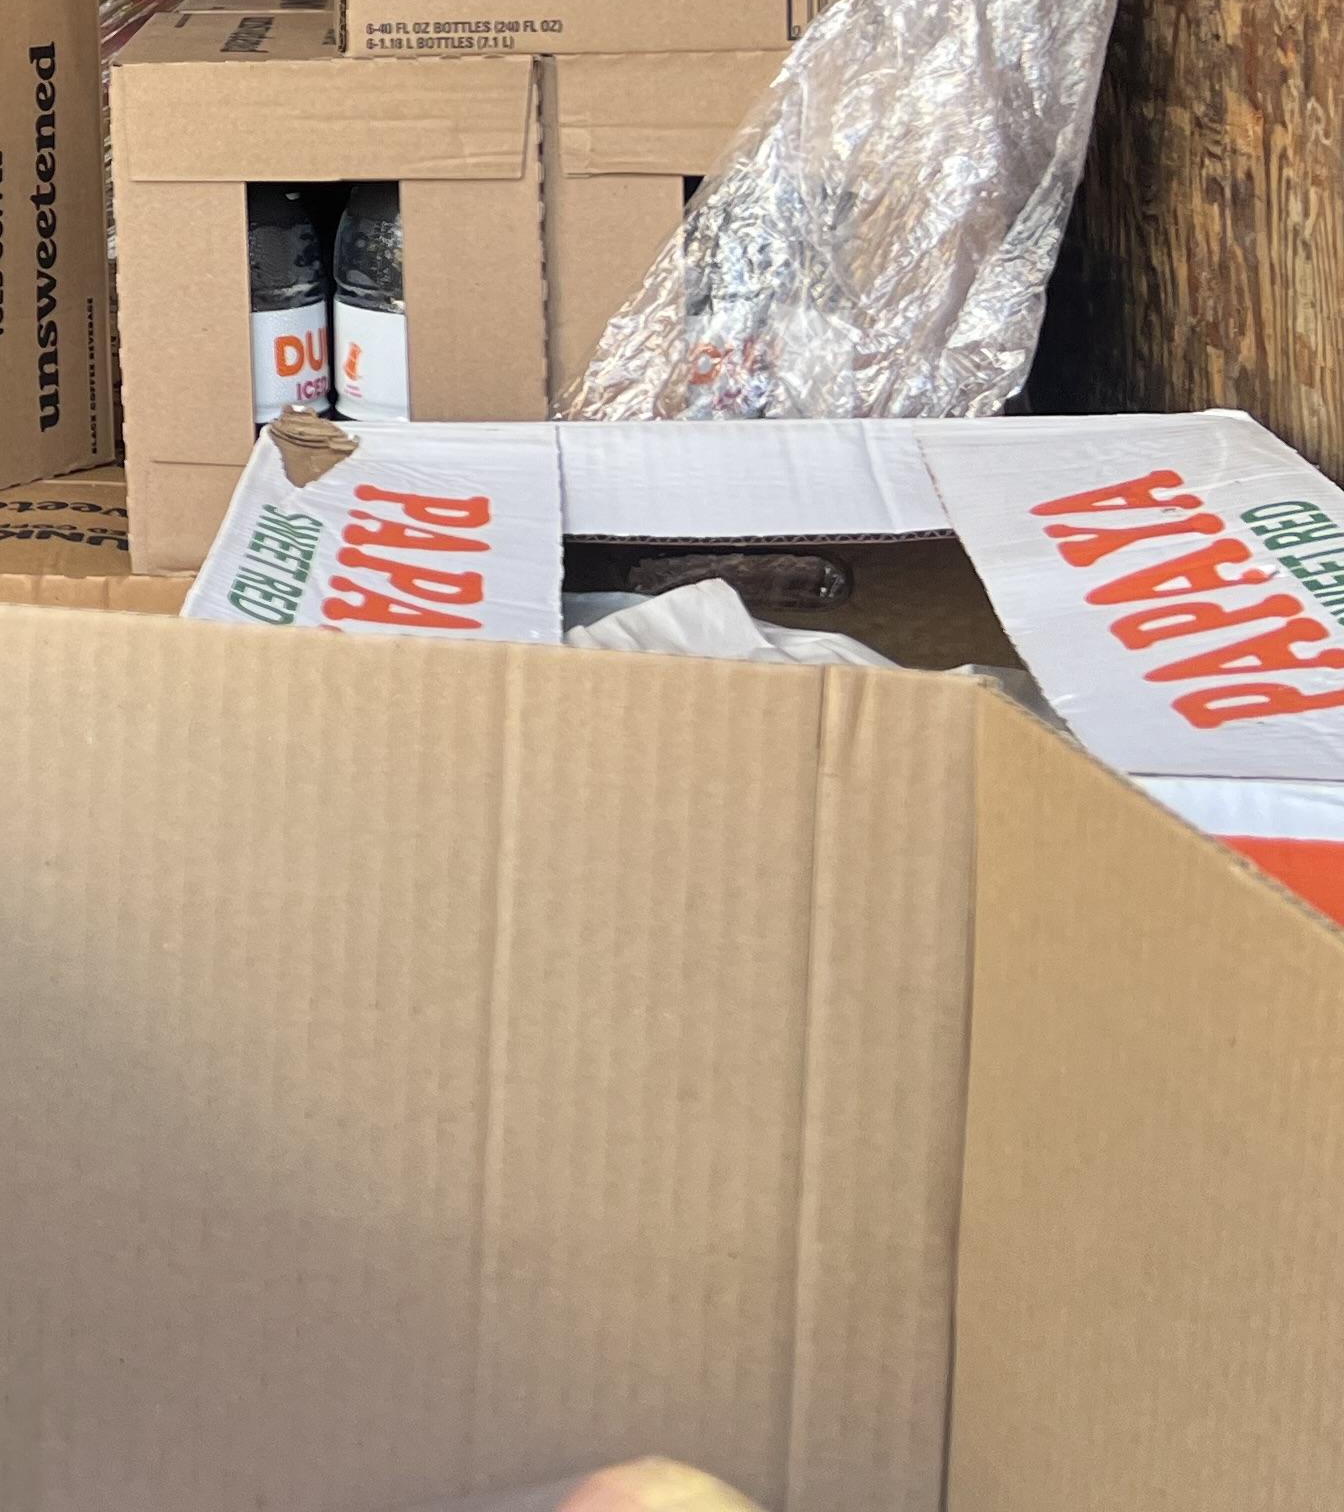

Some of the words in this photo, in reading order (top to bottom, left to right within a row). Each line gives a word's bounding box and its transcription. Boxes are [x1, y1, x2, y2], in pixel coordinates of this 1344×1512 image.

[396, 23, 410, 34] FL
[413, 22, 429, 34] OZ
[433, 21, 491, 33] BOTTLES
[417, 37, 473, 49] BOTTLES
[29, 41, 61, 433] unsweetened
[245, 504, 323, 584] SWEET
[321, 484, 492, 632] PAPA
[227, 566, 304, 626] RED
[1029, 469, 1344, 729] PAPAYA
